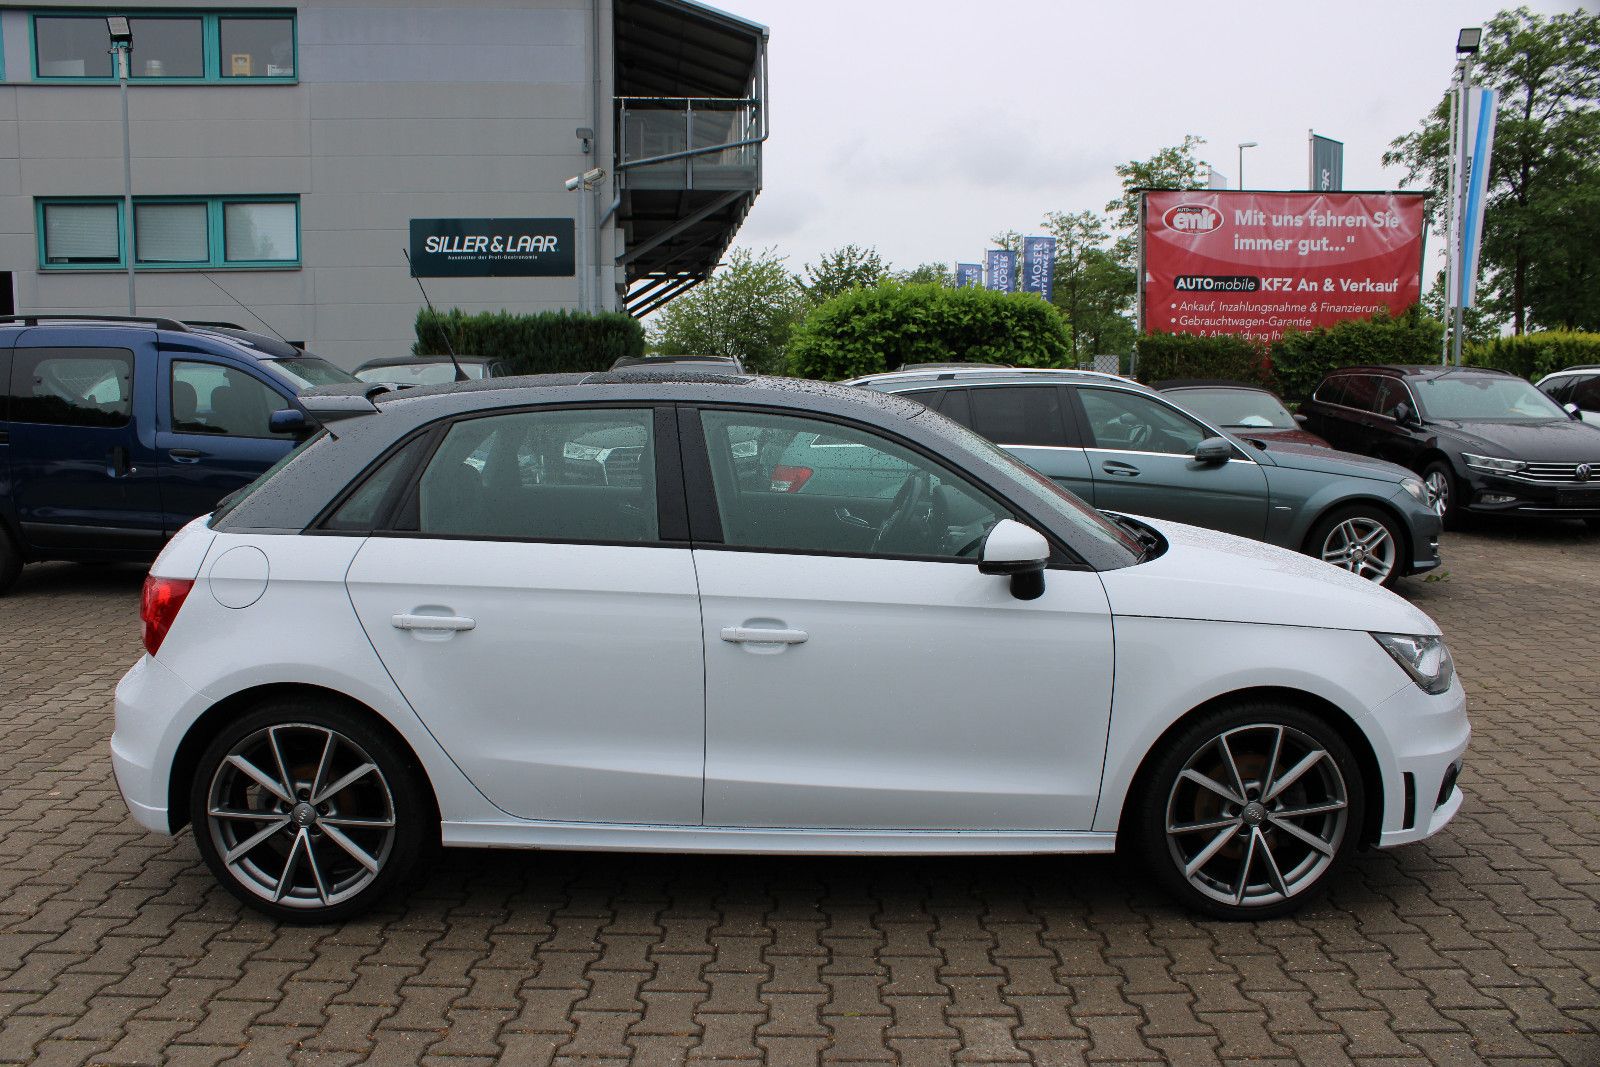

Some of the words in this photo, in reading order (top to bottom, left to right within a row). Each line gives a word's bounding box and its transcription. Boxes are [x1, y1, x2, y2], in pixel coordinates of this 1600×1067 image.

[1173, 208, 1216, 229] emir
[1235, 209, 1266, 226] Mit
[1272, 214, 1303, 227] uns
[1309, 210, 1366, 227] fahren
[1373, 210, 1399, 228] Sie
[1234, 233, 1293, 251] immer
[1031, 242, 1043, 288] MOSER
[1176, 277, 1256, 291] AUTOmobile
[1261, 277, 1293, 291] KFZ
[1297, 277, 1318, 292] An
[1323, 277, 1335, 292] &
[1340, 277, 1399, 292] Verkauf
[1179, 301, 1216, 313] Ankauf,
[1219, 301, 1307, 314] Inzahlungsnahme
[1309, 302, 1318, 313] &
[1180, 315, 1312, 328] Gebrauchtwagen-Garantie
